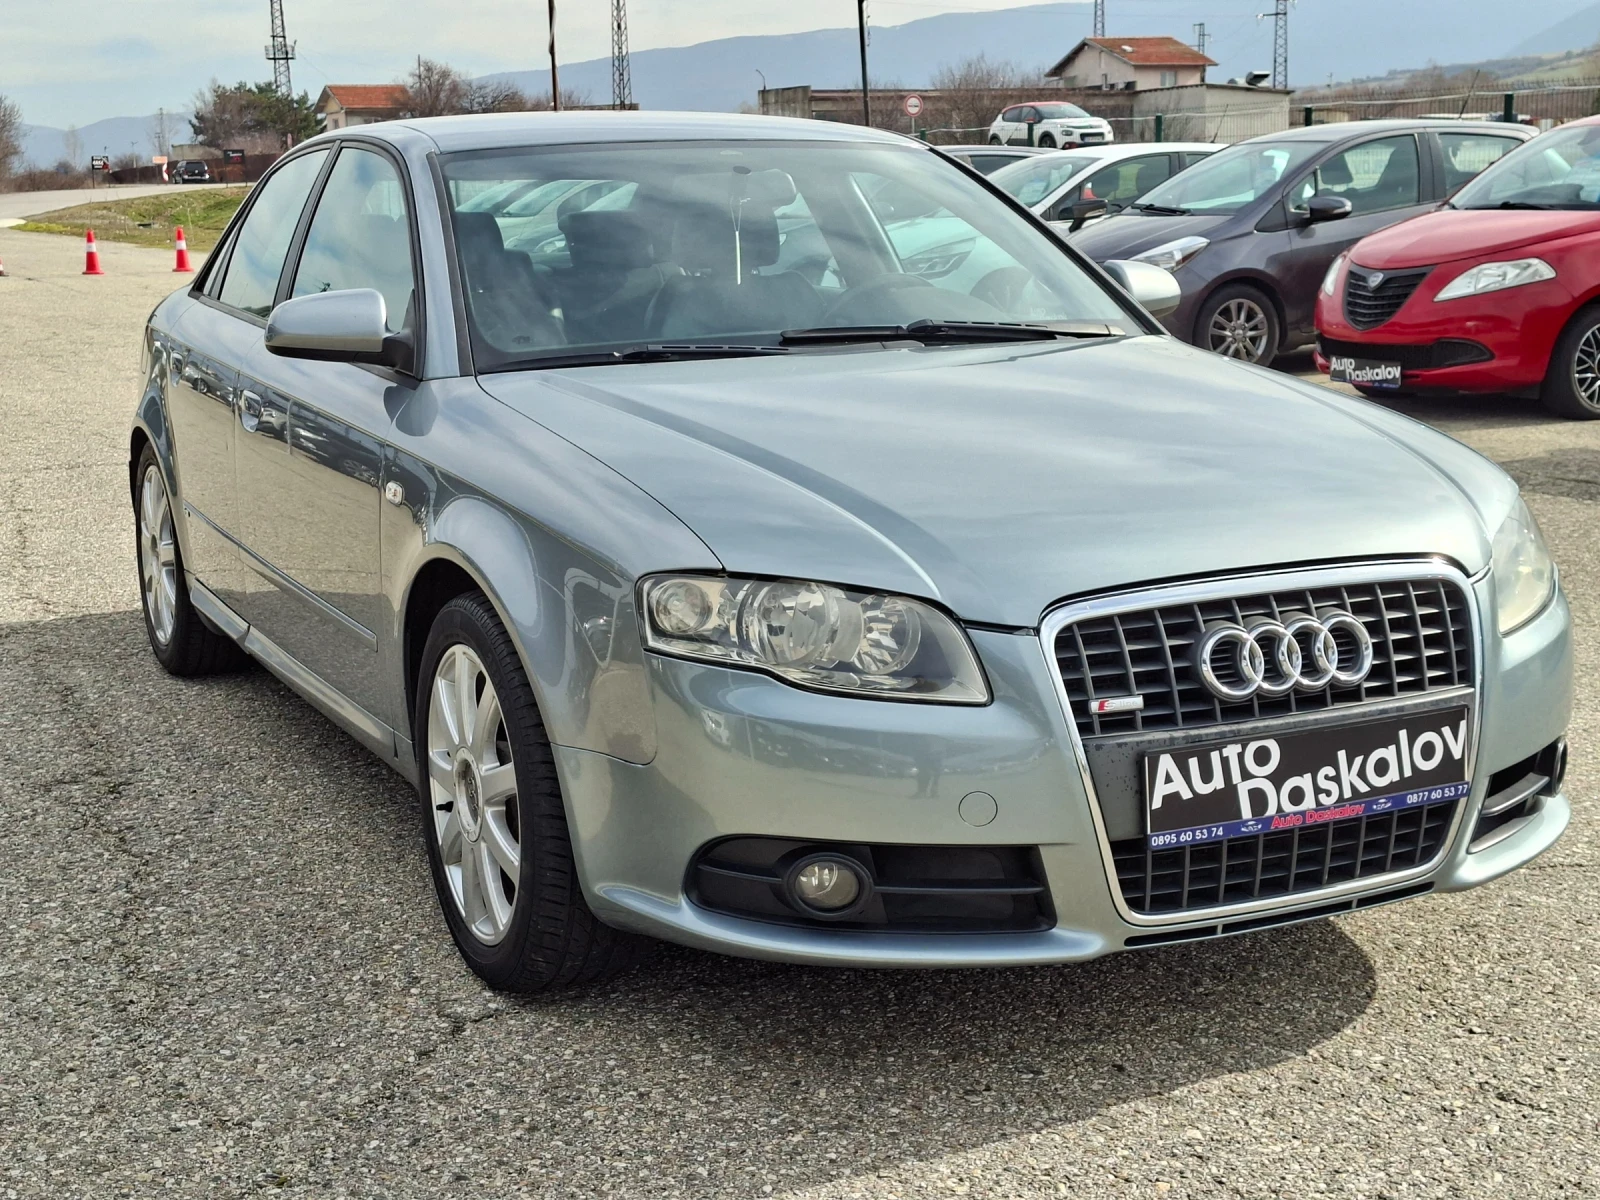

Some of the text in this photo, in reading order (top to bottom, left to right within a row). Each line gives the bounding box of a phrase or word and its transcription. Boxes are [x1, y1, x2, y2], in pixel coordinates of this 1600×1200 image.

[1331, 357, 1355, 371] Auto
[1151, 738, 1281, 810] Auto
[1236, 719, 1467, 820] Daskalov
[1406, 784, 1468, 804] 0877 60 53 77
[1271, 804, 1365, 829] Auto Daskalov
[1151, 827, 1224, 846] 0895 60 53 74
